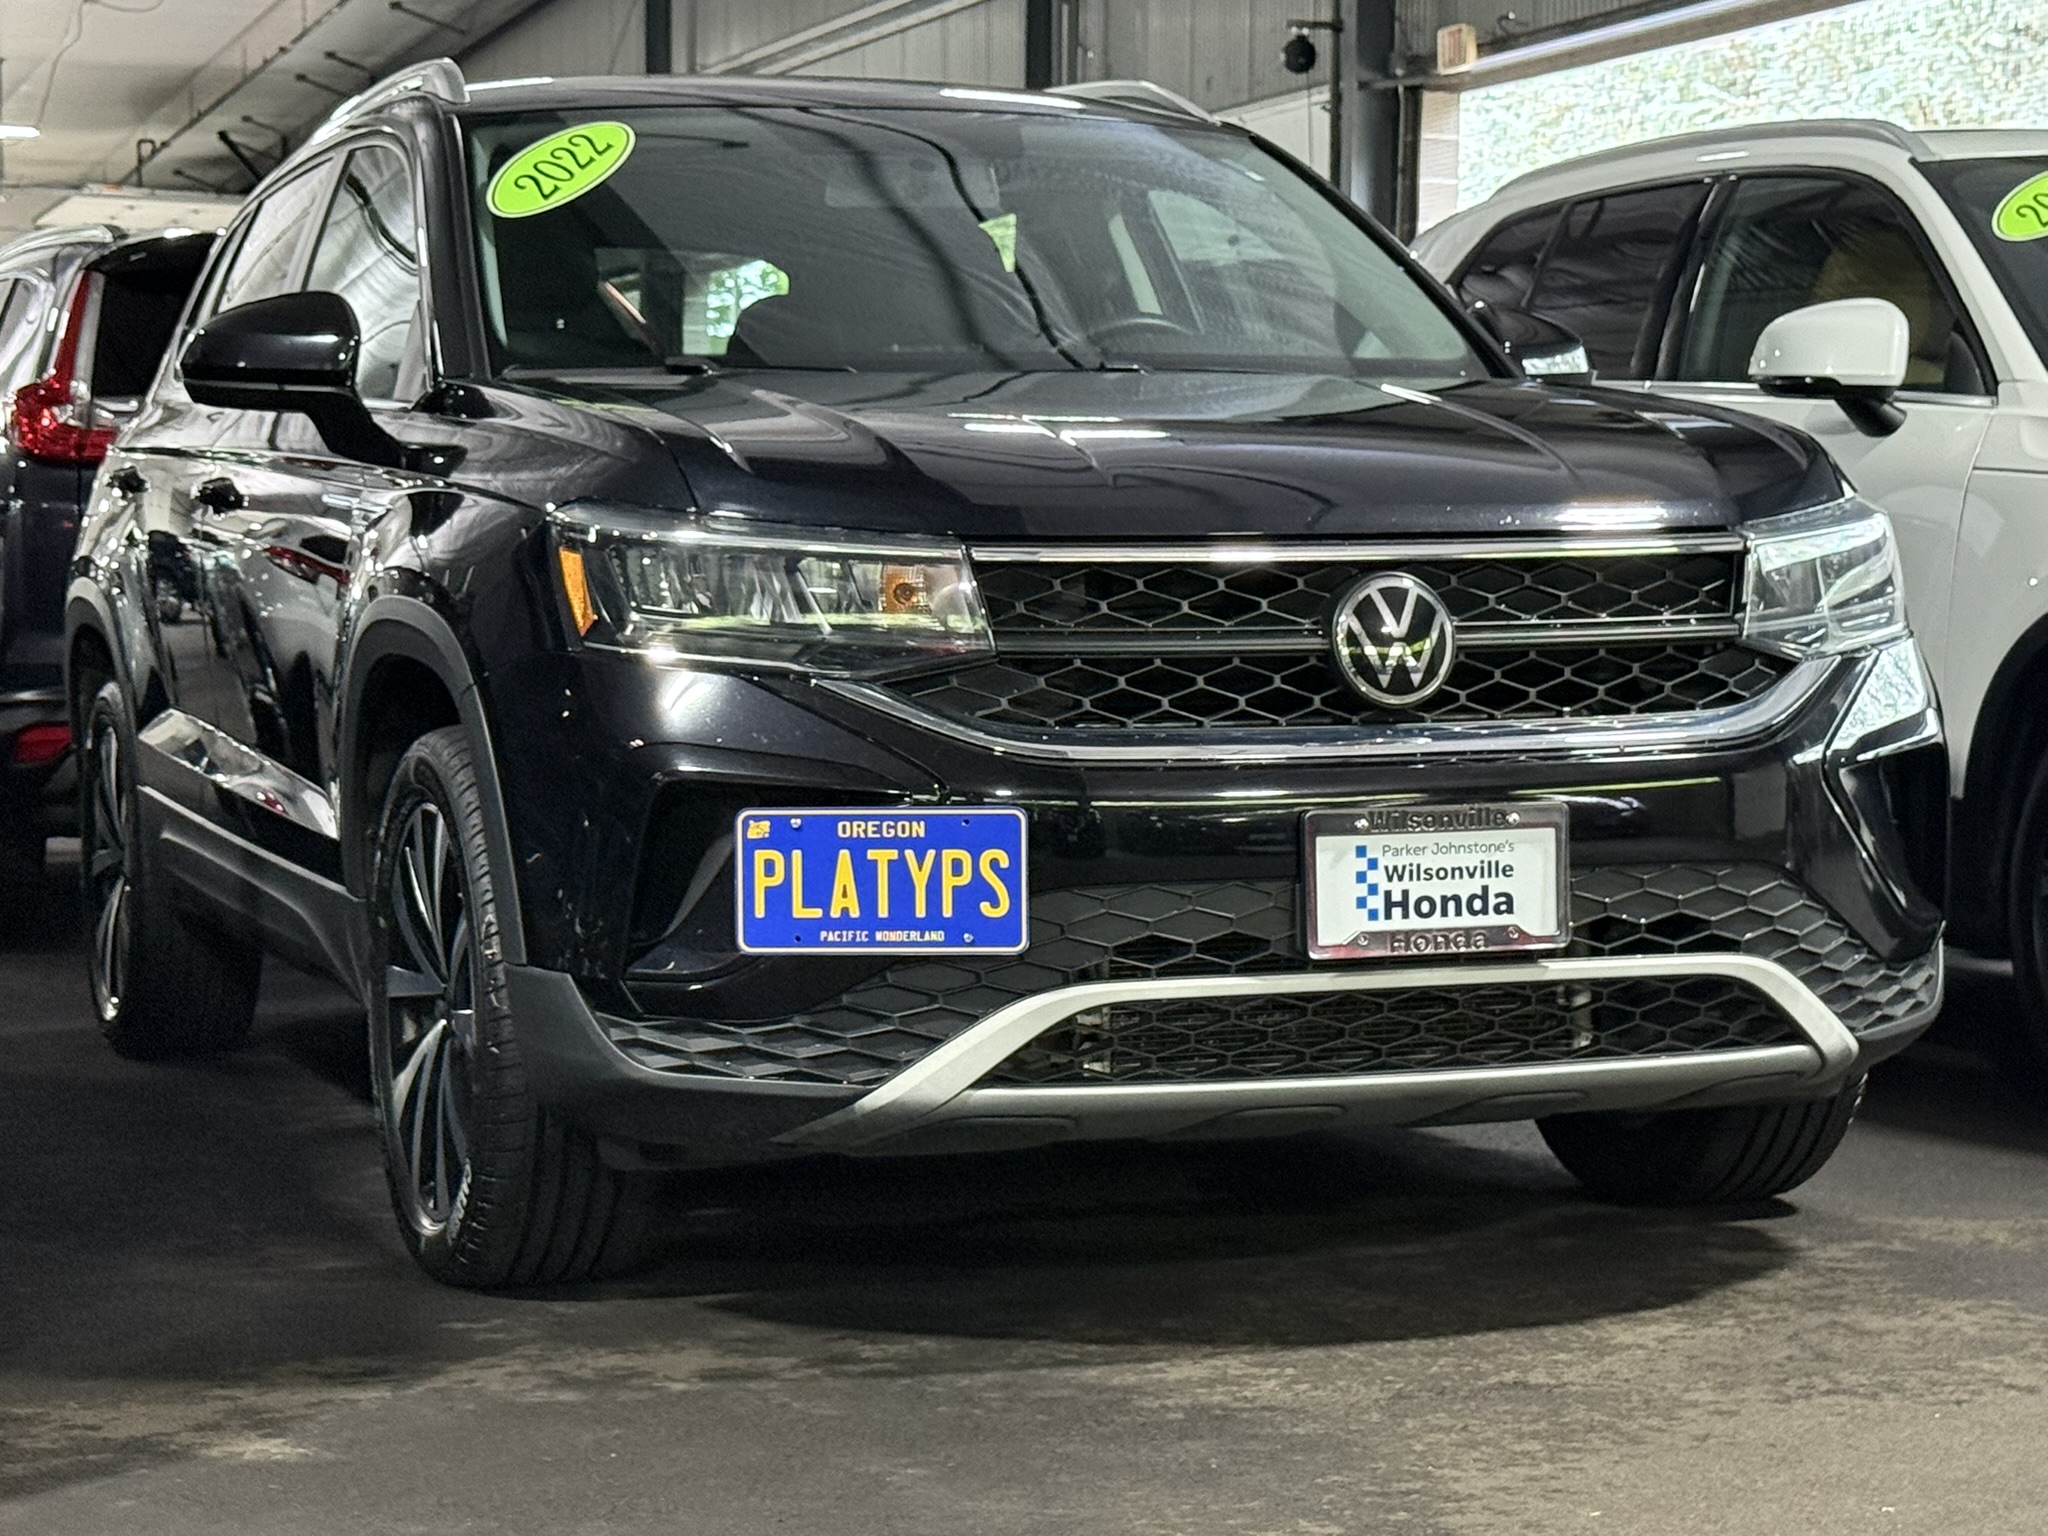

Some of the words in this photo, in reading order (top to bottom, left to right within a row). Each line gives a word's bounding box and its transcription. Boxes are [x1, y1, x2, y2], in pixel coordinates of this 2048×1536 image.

[514, 134, 614, 200] 2022
[837, 820, 926, 838] OREGON
[1382, 844, 1427, 857] Parker
[1431, 840, 1515, 856] Johnstone's
[1384, 860, 1515, 883] Wilsonville
[753, 849, 1011, 918] PLATYPS
[1383, 885, 1515, 920] Honda
[820, 931, 869, 943] PACIFIC
[875, 931, 945, 943] WONDERLAND
